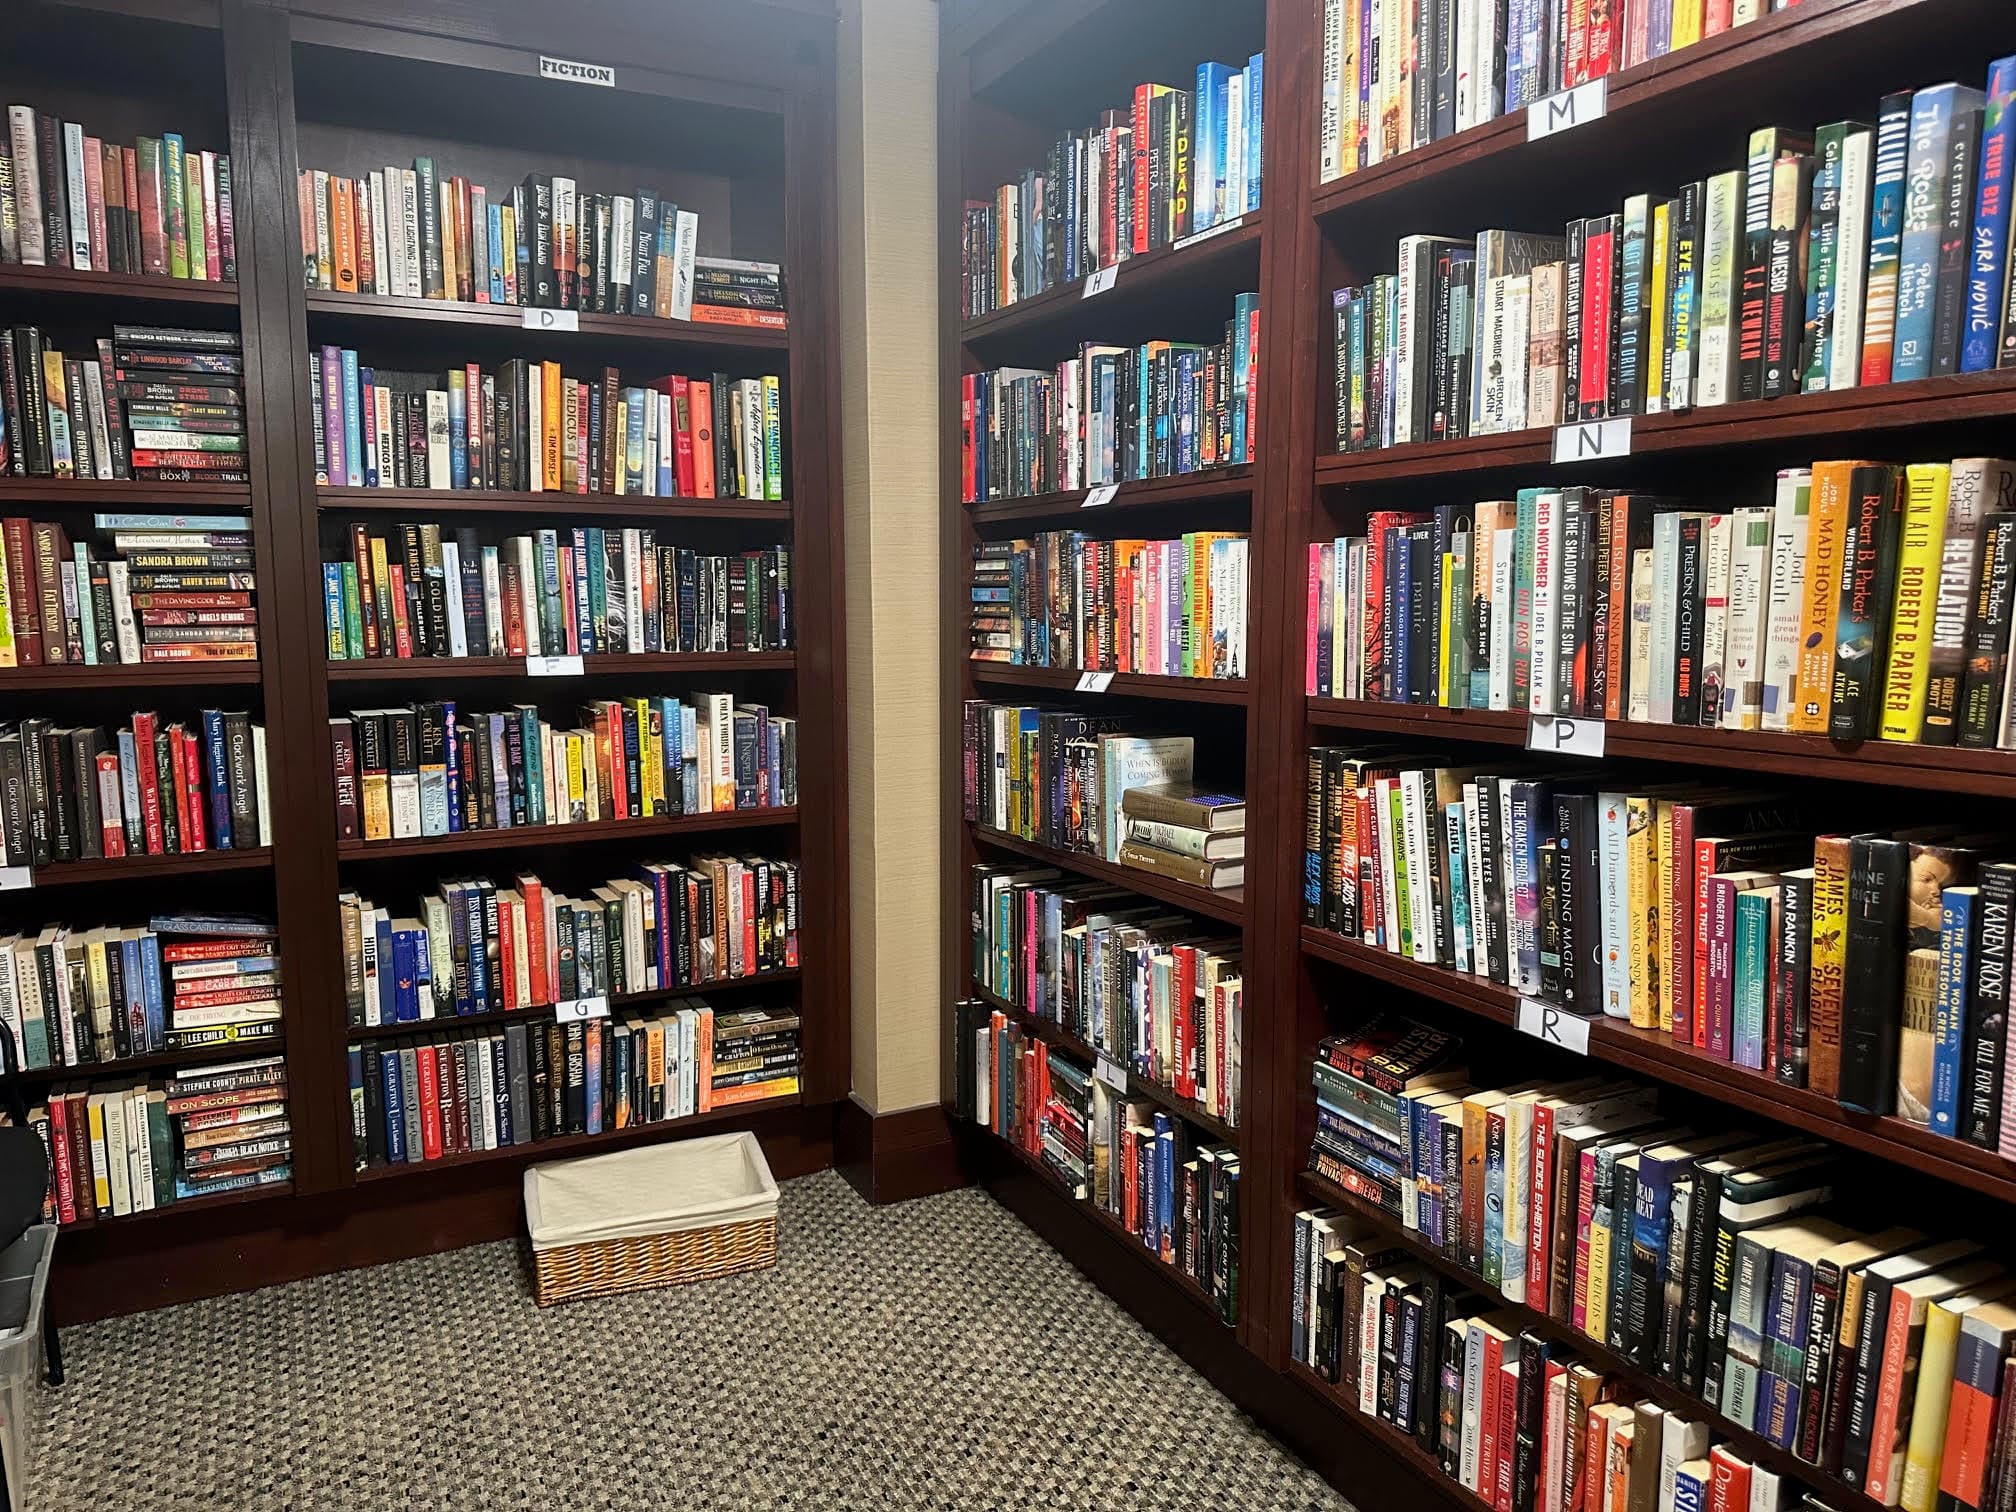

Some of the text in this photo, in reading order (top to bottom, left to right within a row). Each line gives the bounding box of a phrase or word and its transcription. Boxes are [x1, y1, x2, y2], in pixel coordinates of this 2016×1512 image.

[542, 60, 610, 81] FICTION
[1549, 92, 1575, 131] M
[1150, 148, 1159, 192] PETRA
[1177, 138, 1187, 213] DEAD
[1746, 153, 1770, 233] DROWNING
[1906, 104, 1938, 234] The Rocks
[1950, 142, 1965, 227] evermore
[404, 187, 413, 215] STRUCK
[423, 167, 434, 244] DAMNATION SPRING
[407, 226, 416, 260] LIGHTNING
[1709, 184, 1725, 299] SWAN HOUSE
[1773, 240, 1789, 253] JO
[1864, 112, 1906, 344] FALLING T.J. NEWMAN
[1972, 134, 2004, 332] TRUE BIZ SARA NOVIĆ
[1679, 240, 1692, 272] EYE
[1813, 142, 1837, 367] Celeste Ng Little Fires Everywhere
[1093, 273, 1102, 290] H
[1399, 243, 1409, 363] CURSE OF THE NARROWS
[1567, 263, 1580, 342] AMERICAN RUST
[1900, 263, 1913, 318] Nichols
[1915, 263, 1931, 308] Peter
[542, 311, 554, 325] D
[1494, 280, 1504, 359] STUART MACBRIDE
[1676, 293, 1689, 350] STORM
[1740, 266, 1765, 360] T.J. NEWMAN
[1769, 295, 1784, 345] MIDNIGHT
[1767, 346, 1780, 362] SUN
[102, 355, 119, 430] DEAR WIFE
[566, 386, 577, 441] MEDICUS
[1486, 388, 1496, 415] SKIN
[1495, 379, 1504, 422] BROKEN
[77, 431, 89, 476] OVERWATCH
[381, 433, 391, 479] MEXICO SET
[766, 388, 780, 477] JANET EVANOVICH
[1578, 424, 1602, 456] N
[137, 555, 208, 566] SANDRA BROWN
[1170, 548, 1179, 607] ELLE KENNEDY
[1561, 501, 1579, 654] IN THE SHADOWS OF THE SUN
[1773, 534, 1794, 604] Picoult
[1791, 552, 1807, 584] Jodi
[1812, 519, 1833, 630] MAD HONEY
[1843, 527, 1856, 591] WONDERLAND
[1851, 496, 1881, 624] Robert B. Parker's
[431, 581, 445, 639] COLD HIT
[1534, 503, 1549, 688] RED NOVEMBER JOEL POLLAK
[1887, 477, 1934, 713] THIN AIR ROBERT B. PARKER
[1933, 539, 1973, 649] REVELATION
[1182, 614, 1191, 652] TWISTED
[1678, 545, 1695, 698] PRESTON CHILD OLD BONES
[1772, 634, 1800, 643] things
[1774, 625, 1798, 633] great
[1086, 675, 1097, 688] K
[1833, 671, 1844, 704] ATKINS
[1847, 680, 1858, 698] ACE
[423, 718, 433, 755] FOLLETT
[433, 727, 442, 746] KEN
[720, 698, 730, 777] COLIN FORBES FURY
[1555, 720, 1574, 749] P
[232, 734, 249, 815] Clockwork Angel
[1126, 758, 1186, 770] WHEN IS BUDDY
[1128, 770, 1160, 780] COMING
[338, 776, 352, 806] NEVER
[1396, 818, 1404, 862] SIDEWAYS
[1448, 817, 1460, 854] MAHU
[1479, 787, 1492, 883] BEHIND HER EYES
[1514, 800, 1529, 900] THE KRAKEN PROJECT
[1814, 857, 1828, 922] ROLLINS
[1829, 867, 1844, 917] JAMES
[487, 896, 497, 935] TREACHERY
[1560, 855, 1573, 978] FINDING MAGIC
[1784, 885, 1797, 963] IAN RANKIN
[364, 937, 375, 961] HIDE
[612, 938, 623, 977] TUNNELS
[1954, 951, 1962, 984] BOOK
[1978, 903, 2008, 1000] KAREN ROSE
[1810, 966, 1822, 1032] PLAGUE
[1936, 910, 1952, 1046] OF TROUBLESOME CREEK
[575, 1000, 587, 1015] G
[1174, 953, 1184, 1078] John HUNTER
[1542, 1010, 1562, 1043] R
[1824, 965, 1842, 1047] SEVENTH
[1951, 989, 1961, 1031] WOMAN
[188, 1025, 274, 1043] LEE CHILD MAKE ME
[183, 1072, 282, 1092] STEPHEN COONTS PIRATE ALLEY
[1107, 1067, 1114, 1082] L
[1972, 1038, 1995, 1117] KILL FOR ME
[180, 1095, 239, 1110] ON SCOPE
[1533, 1124, 1545, 1251] THE SUICIDE EXHIBITION
[1220, 1214, 1229, 1293] EYE CONTACT
[1593, 1231, 1604, 1319] KATHY REICHS
[1714, 1228, 1734, 1291] Airtight
[1719, 1312, 1727, 1335] David
[1805, 1292, 1826, 1383] SILENT GIRLS
[1822, 1333, 1831, 1355] THE
[1499, 1459, 1510, 1492] FEARED
